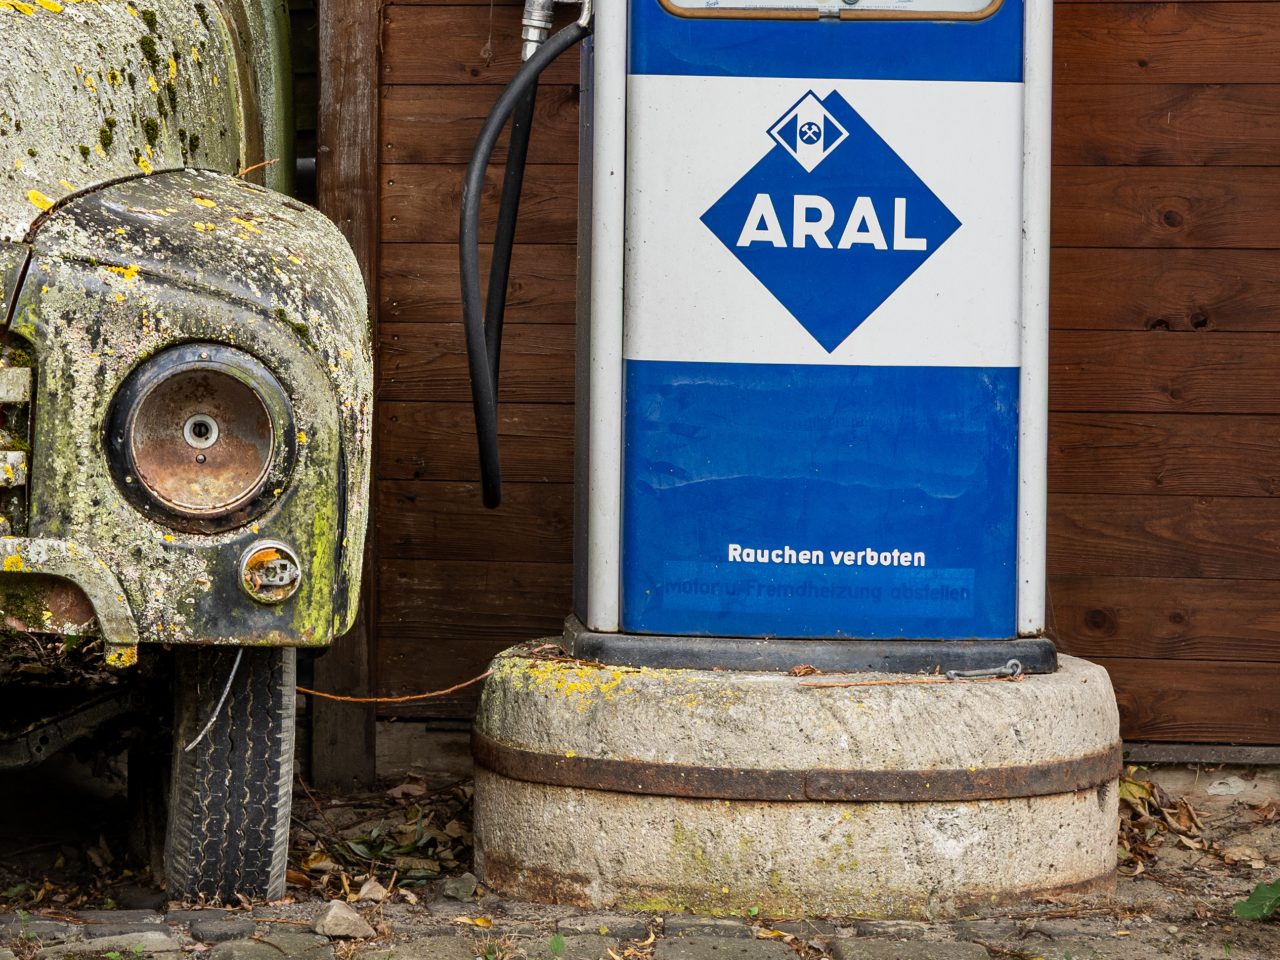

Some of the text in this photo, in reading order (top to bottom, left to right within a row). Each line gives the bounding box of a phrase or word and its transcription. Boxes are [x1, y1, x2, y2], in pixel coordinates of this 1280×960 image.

[736, 193, 927, 251] ARAL
[728, 543, 926, 567] Rauchen verboten
